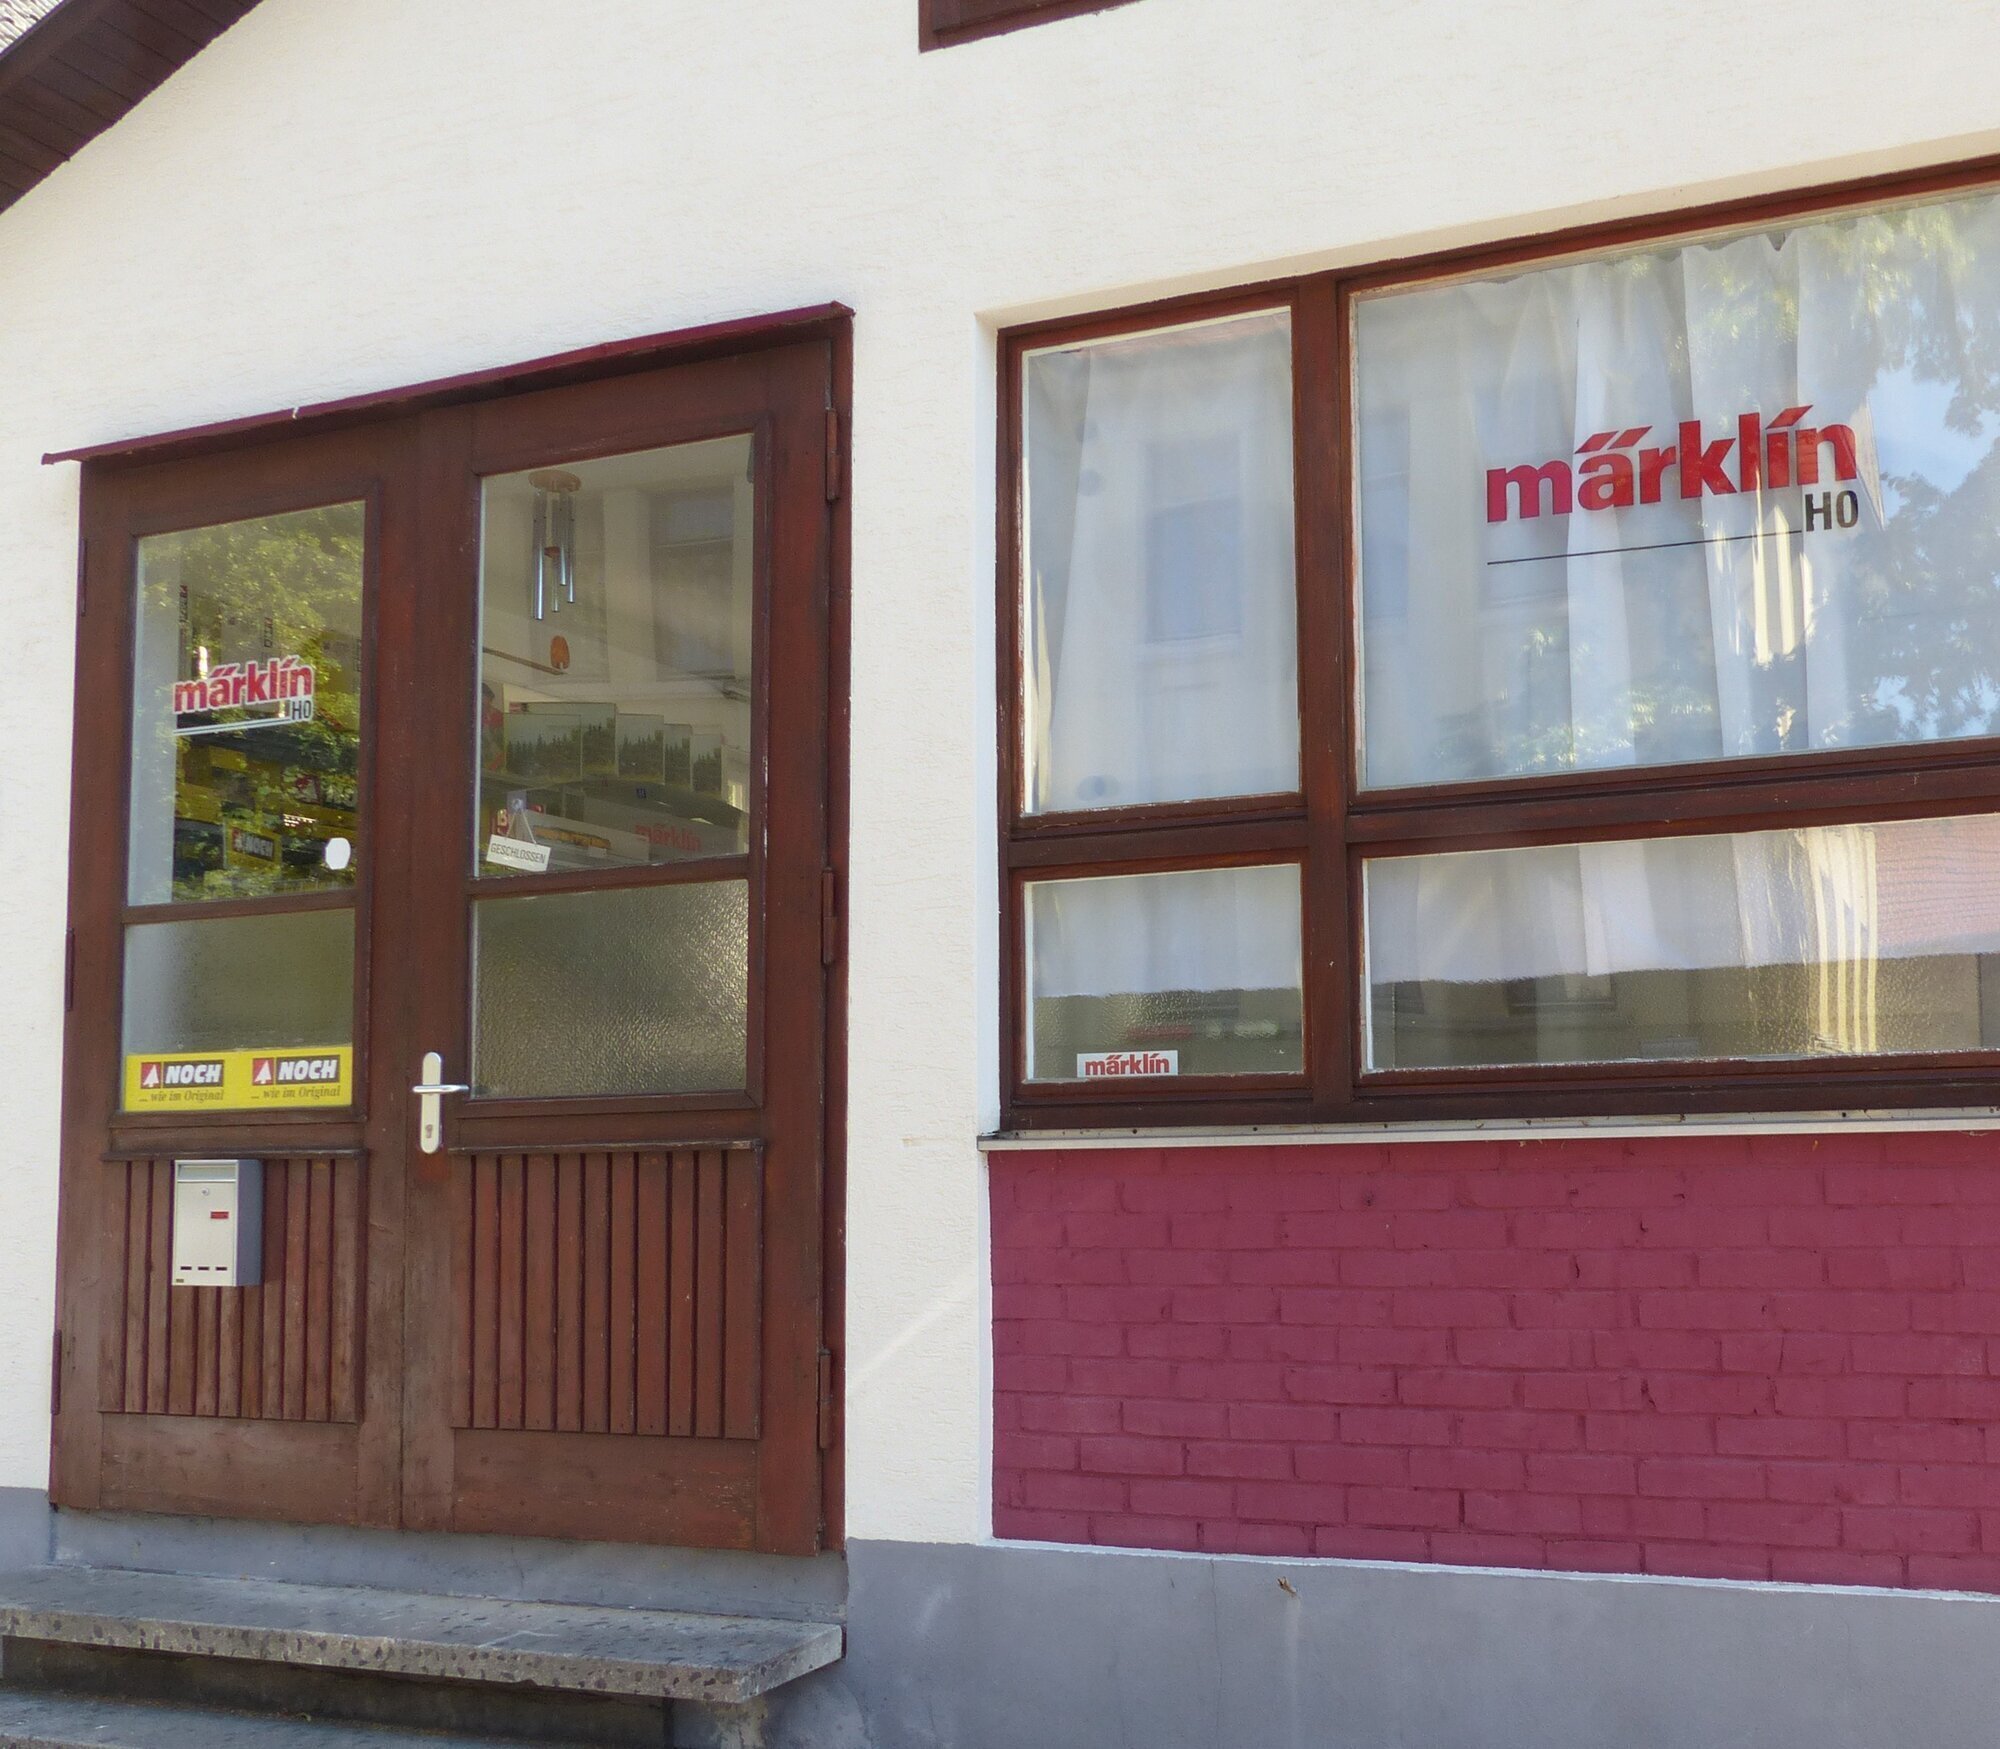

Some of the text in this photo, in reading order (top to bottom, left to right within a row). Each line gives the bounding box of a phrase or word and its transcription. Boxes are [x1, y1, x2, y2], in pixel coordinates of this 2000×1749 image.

[490, 842, 546, 864] GESCHLOSSEN
[165, 1064, 222, 1084] NOCH
[278, 1059, 337, 1080] NOCH
[185, 1090, 224, 1103] Original
[298, 1085, 340, 1099] Original
